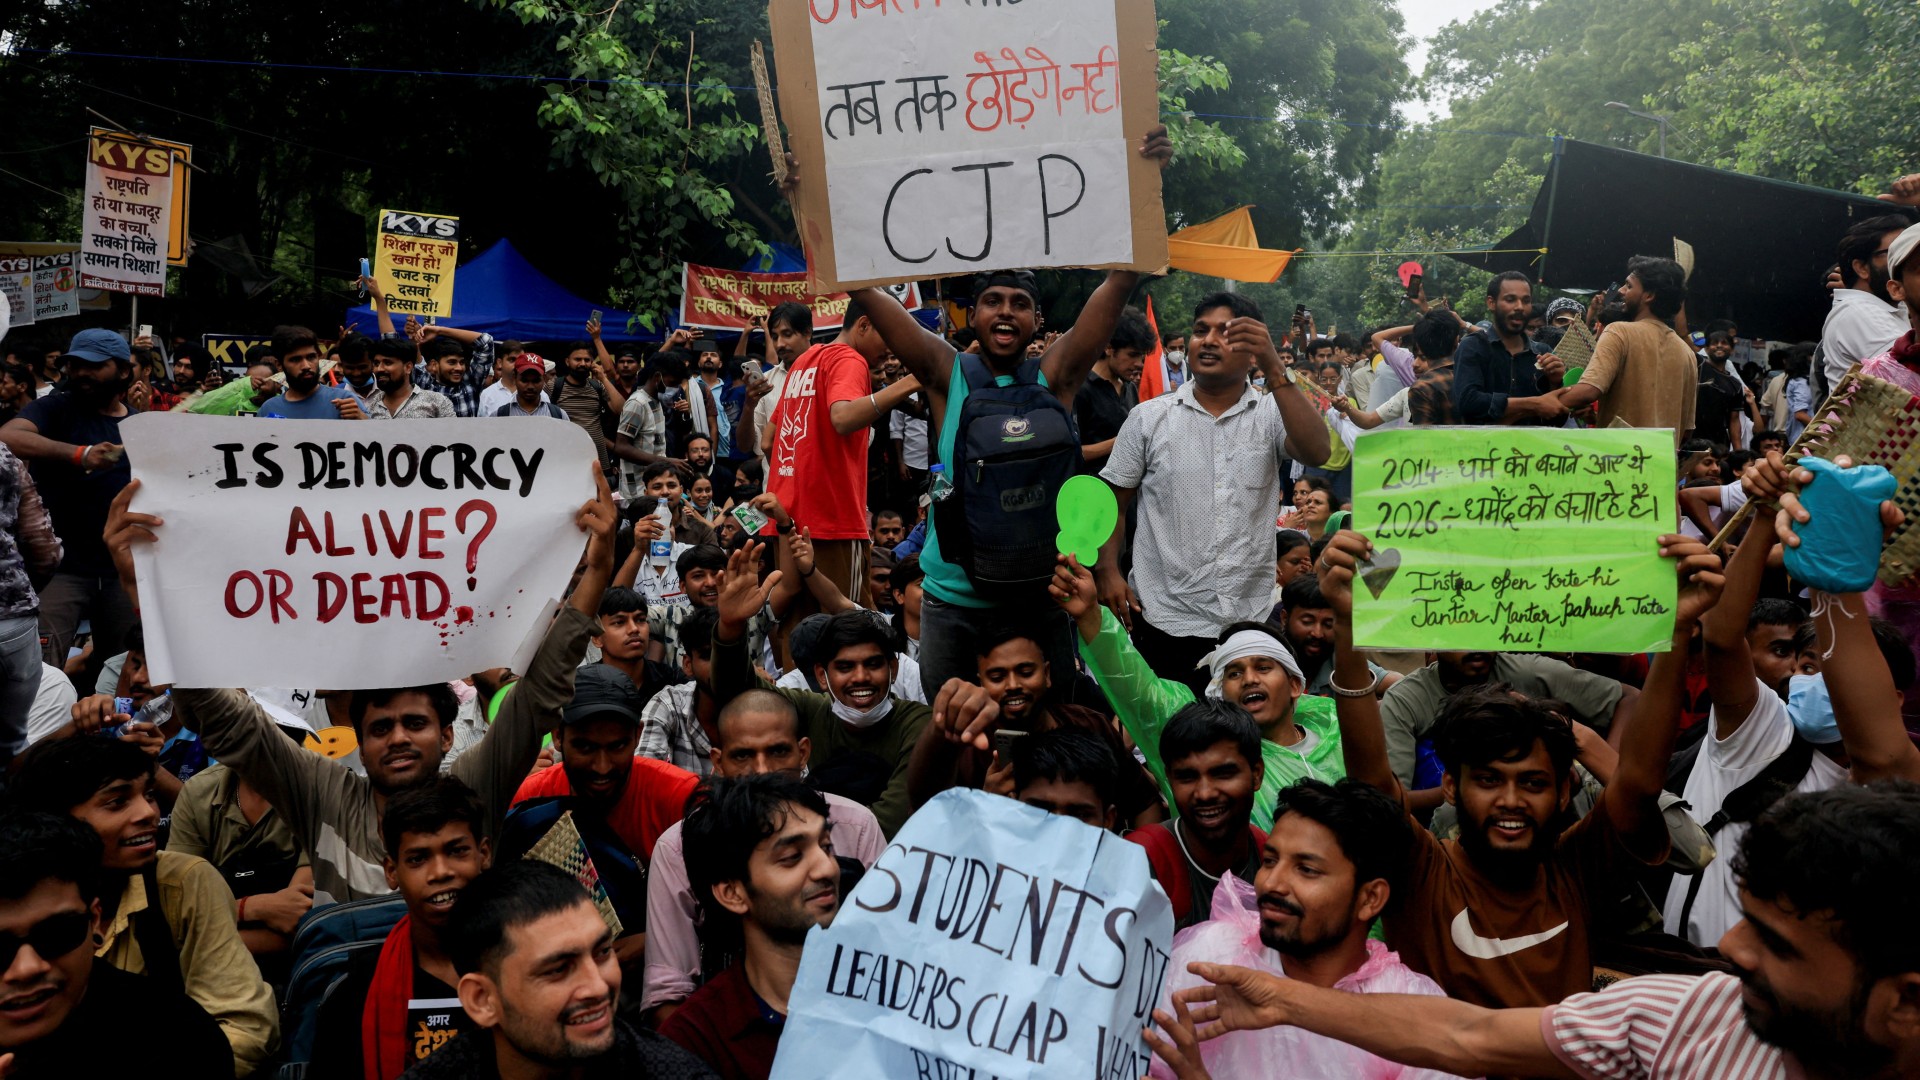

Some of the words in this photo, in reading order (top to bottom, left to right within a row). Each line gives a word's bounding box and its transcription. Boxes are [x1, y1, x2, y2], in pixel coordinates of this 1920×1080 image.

[825, 80, 886, 140] तब
[894, 75, 957, 133] तक
[92, 138, 169, 174] KYS
[105, 177, 150, 197] राष्ट्रपति
[92, 192, 105, 211] हो
[106, 198, 123, 213] या
[125, 202, 162, 224] मजदूर
[99, 215, 116, 231] का
[118, 219, 151, 238] बच्चा,
[382, 211, 455, 237] KYS
[91, 233, 129, 251] सबको
[131, 235, 157, 255] मिले
[383, 235, 416, 253] शिक्षा
[419, 242, 435, 254] पर
[438, 242, 455, 257] जो
[36, 253, 70, 268] KYS
[83, 252, 121, 269] समान
[122, 252, 160, 275] शिक्षा!
[392, 253, 420, 267] खर्चा
[422, 255, 441, 270] हो!
[392, 268, 420, 281] बजट
[422, 272, 440, 284] का
[698, 274, 739, 294] राष्ट्रपति
[740, 276, 755, 296] हो
[756, 281, 772, 295] या
[773, 281, 808, 300] मजदूर
[384, 294, 419, 310] हिस्सा
[421, 298, 439, 313] हो!
[397, 284, 431, 297] दसवां
[693, 295, 737, 316] सबको
[814, 296, 851, 317] शिक्ष
[213, 441, 284, 489] IS
[294, 441, 545, 498] DEMOCRCY
[1458, 448, 1501, 482] धर्म
[1504, 447, 1535, 478] को
[1536, 445, 1583, 476] बचाने
[1628, 445, 1652, 474] थे
[1518, 484, 1554, 521] को
[286, 499, 497, 591] ALIVE?
[1491, 568, 1536, 599] open
[1588, 566, 1620, 586] hi
[224, 568, 298, 624] OR
[312, 570, 450, 624] DEAD
[1411, 598, 1490, 627] Jantar
[1491, 601, 1560, 625] Mantar
[855, 843, 1138, 989] STUDENTS
[826, 943, 966, 1031] LEADERS
[966, 993, 1068, 1064] CLAP
[426, 1014, 450, 1026] अगर
